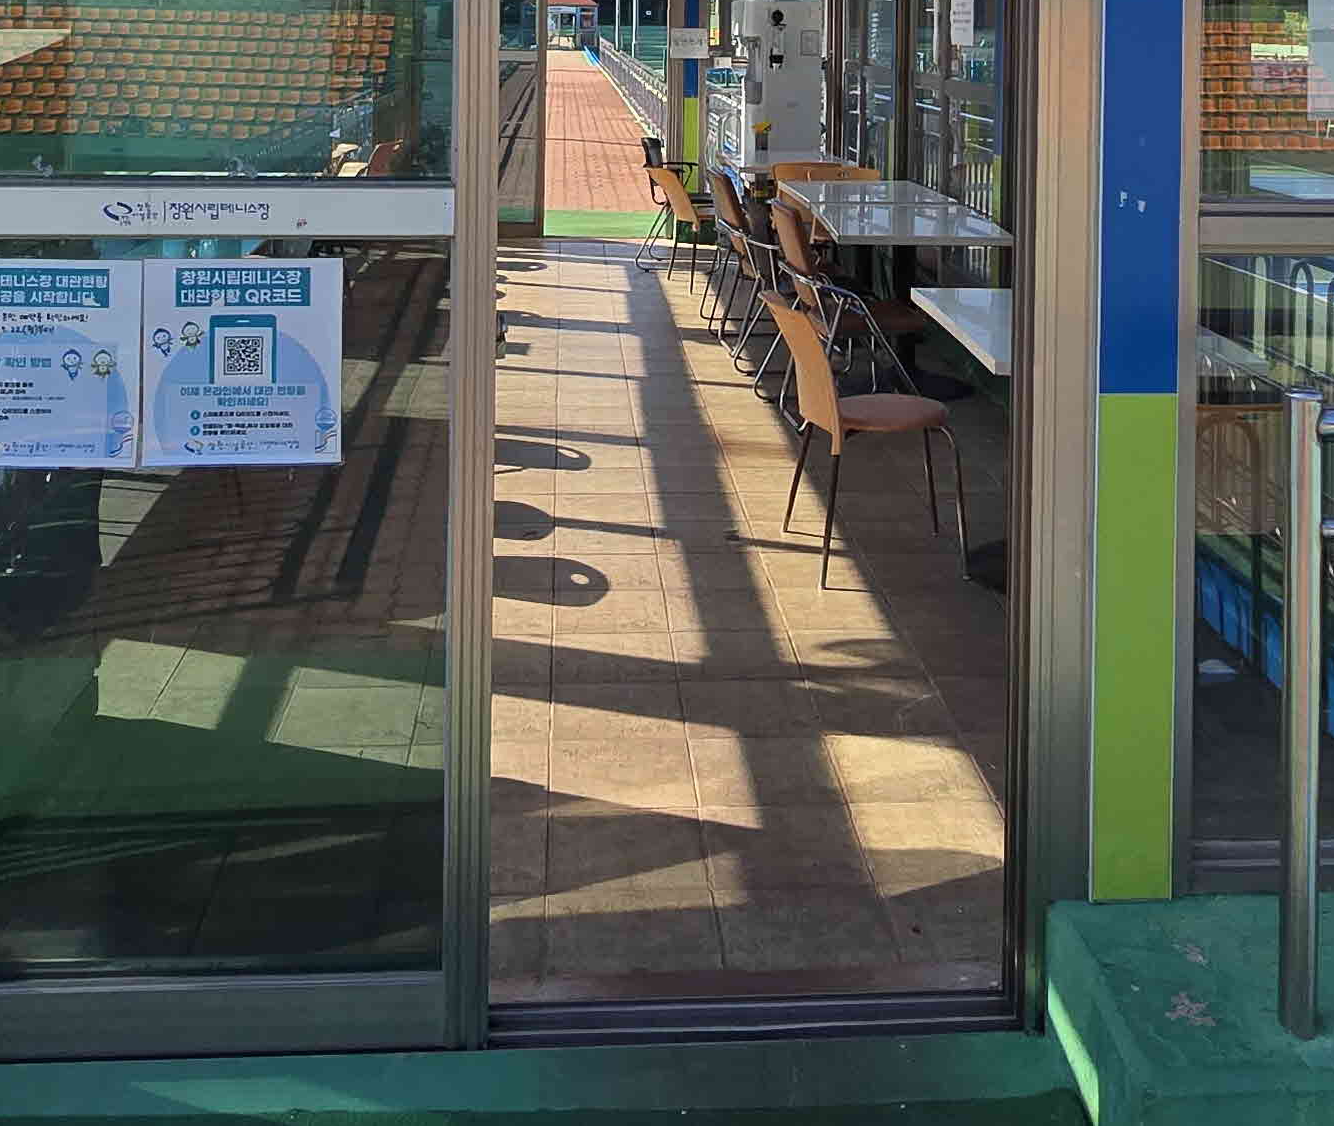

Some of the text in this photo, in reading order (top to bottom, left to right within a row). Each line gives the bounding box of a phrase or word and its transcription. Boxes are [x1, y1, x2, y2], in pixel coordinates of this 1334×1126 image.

[169, 203, 269, 220] 창원시립테니스장
[56, 275, 108, 289] 대관현황
[181, 270, 302, 285] 창원시립테니스장
[245, 288, 303, 304] QR코드
